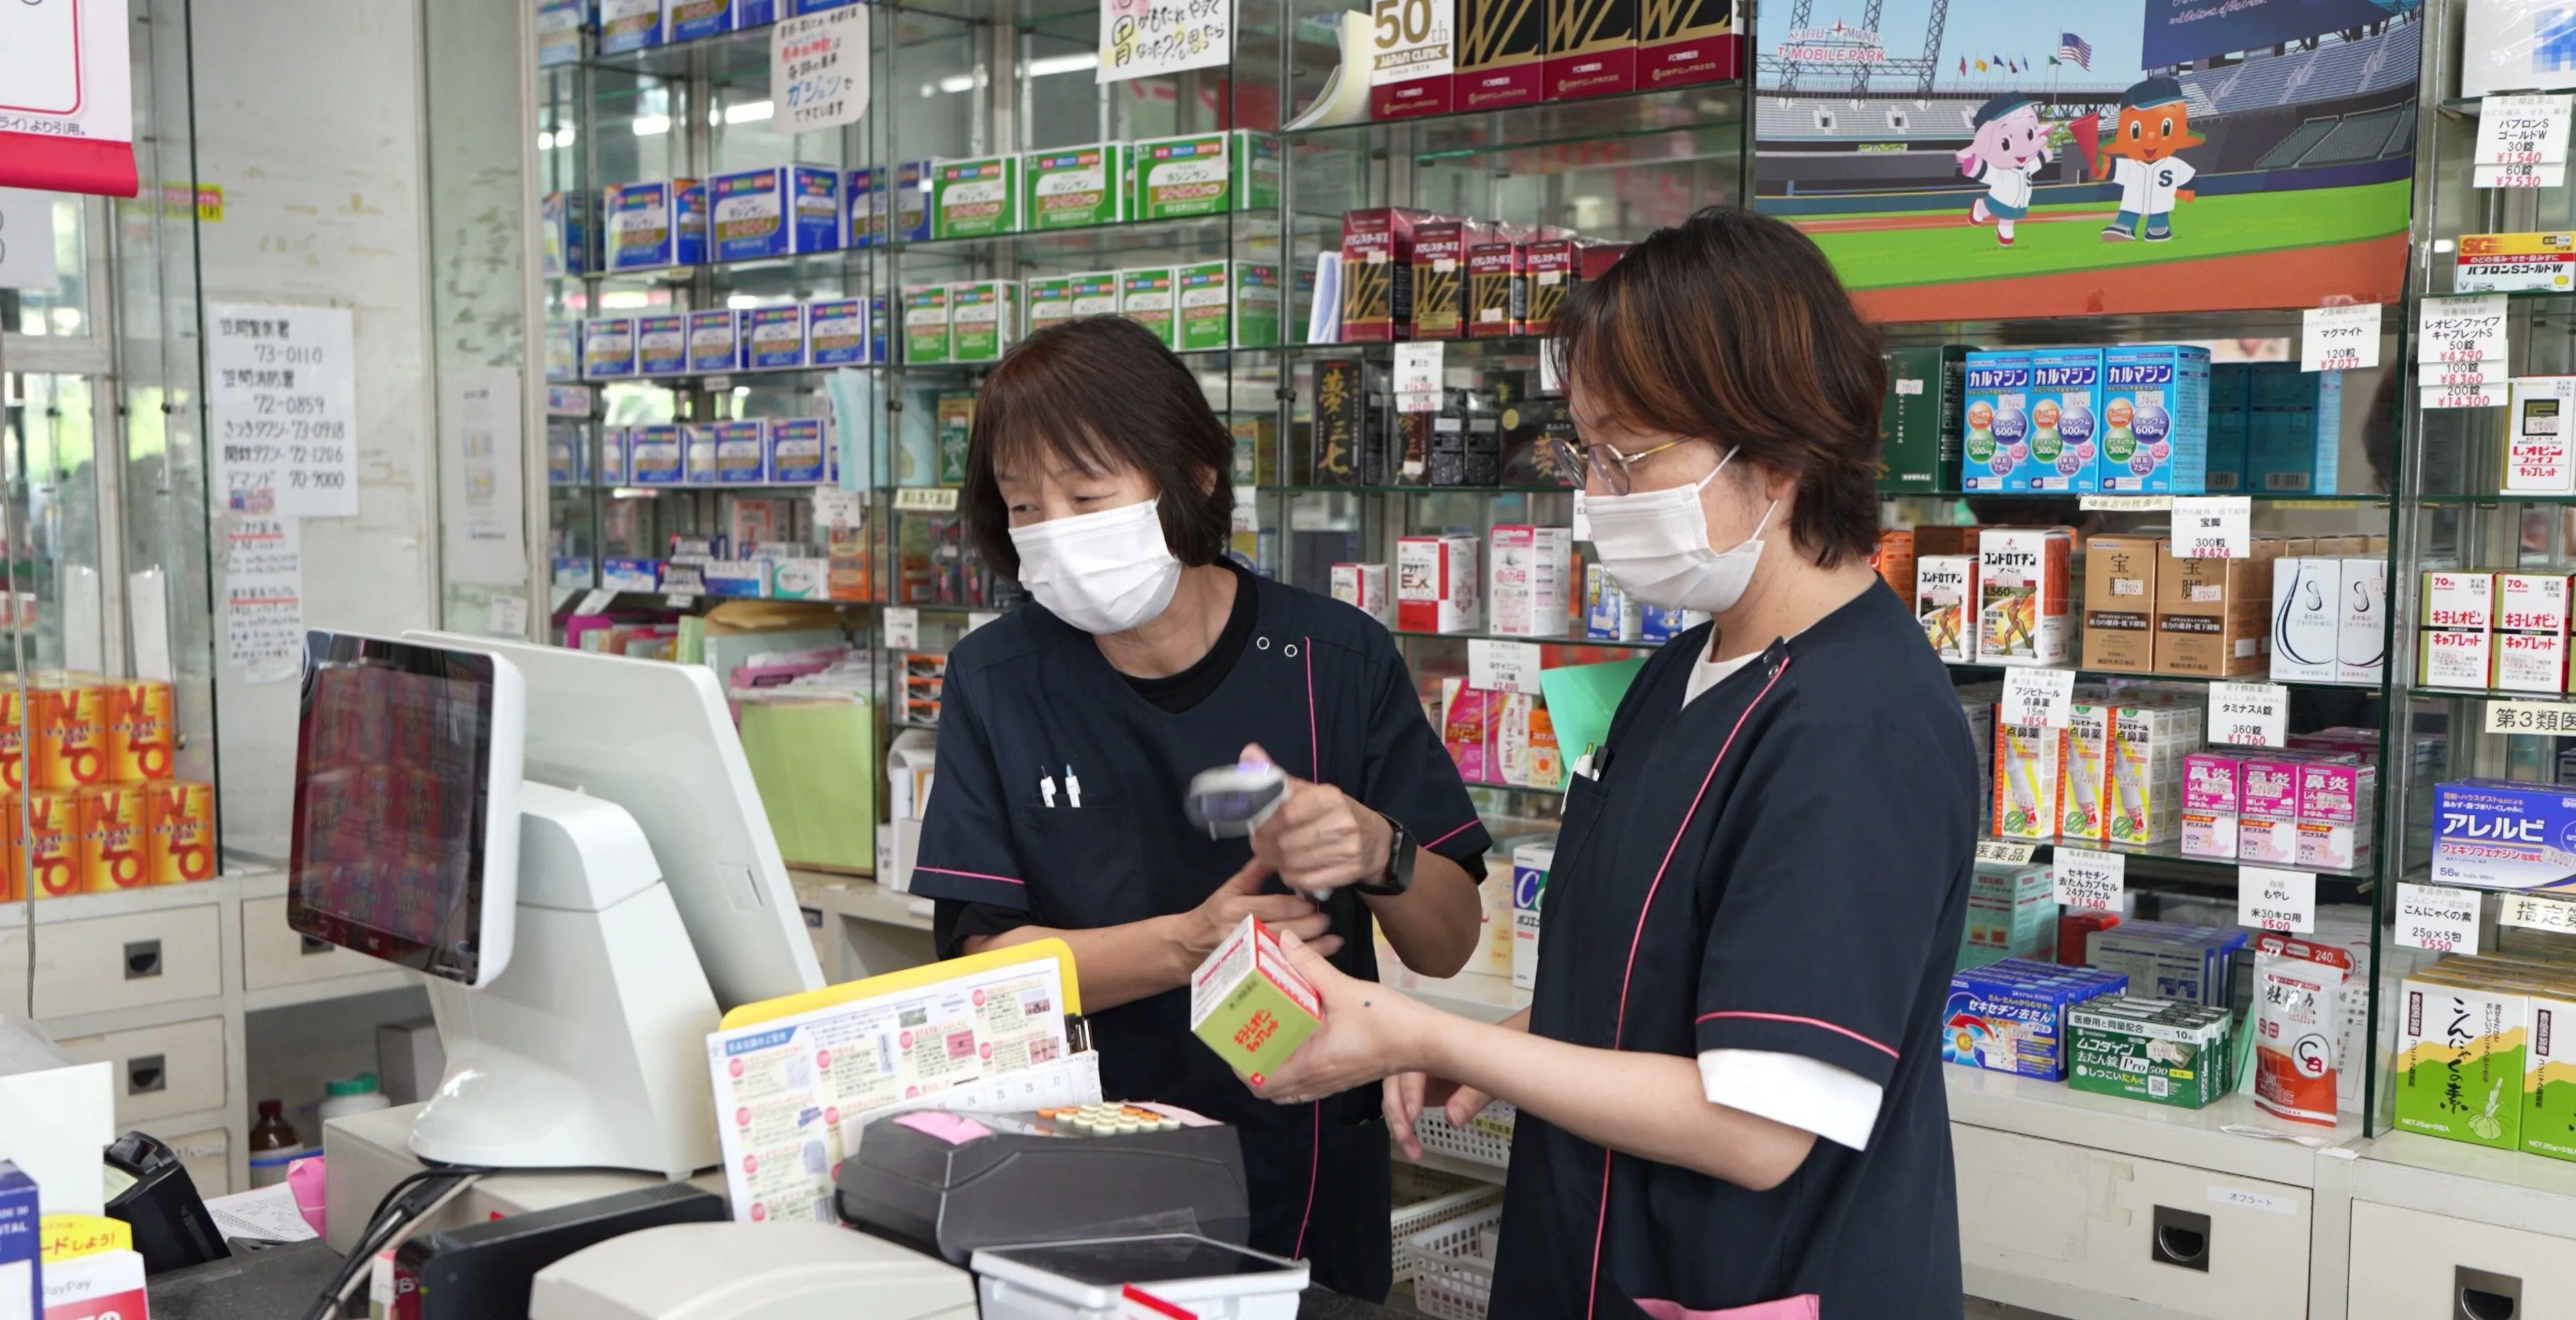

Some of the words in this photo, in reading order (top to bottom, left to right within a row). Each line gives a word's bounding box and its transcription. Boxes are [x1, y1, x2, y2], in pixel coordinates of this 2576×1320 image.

[1844, 28, 1881, 43] MARINERS
[1379, 52, 1410, 67] JAPAN
[1411, 46, 1443, 62] CLINIC
[1849, 49, 1886, 62] PARK
[2499, 118, 2549, 128] パブロンS
[2498, 130, 2547, 141] ゴールドW
[2507, 141, 2534, 152] 30錠
[2506, 165, 2533, 176] 60錠
[2158, 169, 2174, 188] S
[2467, 263, 2564, 276] パブロンSゴールドW
[2425, 316, 2502, 330] レオピンファイブ
[2320, 327, 2363, 338] マグマイト
[2432, 328, 2493, 340] キャプレットS
[2449, 340, 2475, 350] 50錠
[254, 343, 324, 365] 73-0110
[2326, 348, 2356, 359] 120粒
[2447, 362, 2479, 373] 100錠
[1970, 370, 2028, 388] カルマジン
[2035, 368, 2096, 385] カルマジン
[2108, 366, 2171, 384] カルマジン
[2447, 386, 2481, 396] 200錠
[254, 393, 325, 415] 72-0859
[290, 419, 345, 440] 73-0918
[1994, 427, 2023, 437] 600mg
[2061, 426, 2090, 436] 600mg
[2135, 426, 2164, 436] 600mg
[289, 445, 344, 464] 72-1206
[2513, 445, 2563, 456] レオピン
[2519, 466, 2558, 477] キャプレット
[289, 469, 345, 489] 70-9000
[2200, 516, 2221, 528] 宝脚
[2196, 538, 2226, 548] 300粒
[1984, 553, 2037, 566] コンドロイチン
[1495, 570, 1527, 583] 命の母
[1921, 572, 1963, 584] コンドロイチン
[2432, 610, 2485, 625] キヨーレオピン
[2505, 612, 2559, 628] キヨーレオピン
[2433, 633, 2482, 647] キャプレット
[2506, 636, 2557, 650] キャプレット
[2014, 686, 2060, 698] フジビトール
[2023, 696, 2050, 708] 点鼻薬
[2026, 707, 2047, 717] 15ml
[2222, 703, 2273, 716] タミナスA錠
[2021, 715, 2048, 726] ¥854
[2070, 718, 2102, 728] フジビトール
[2496, 708, 2576, 731] 第3類医
[2006, 726, 2039, 739] 点鼻薬
[2068, 726, 2102, 740] 点鼻薬
[2232, 724, 2262, 735] 360錠
[2116, 730, 2149, 744] 点鼻薬
[2304, 775, 2349, 791] 鼻炎
[2443, 813, 2545, 842] アレルビ
[1976, 846, 2025, 863] 医薬品
[2068, 867, 2110, 881] セキセチン
[2058, 877, 2118, 893] 去たんカプセル
[2065, 887, 2111, 900] 24カプセル
[2263, 889, 2290, 901] もやし
[2250, 908, 2302, 923] 米30キロ用
[2404, 905, 2471, 922] こんにゃくの素
[2261, 919, 2291, 932] ¥500
[2412, 927, 2462, 943] 25g×5包
[2420, 939, 2453, 952] ¥550
[2315, 949, 2334, 964] 240
[2074, 1014, 2145, 1034] 医療用と同量配合
[2076, 1037, 2135, 1056] ムコダイン
[2076, 1051, 2118, 1068] 去たん錠
[2440, 996, 2474, 1114] こんにゃくの素
[2121, 1058, 2146, 1072] Pro
[2149, 1065, 2168, 1076] 500
[2088, 1067, 2146, 1085] しつこいたんに
